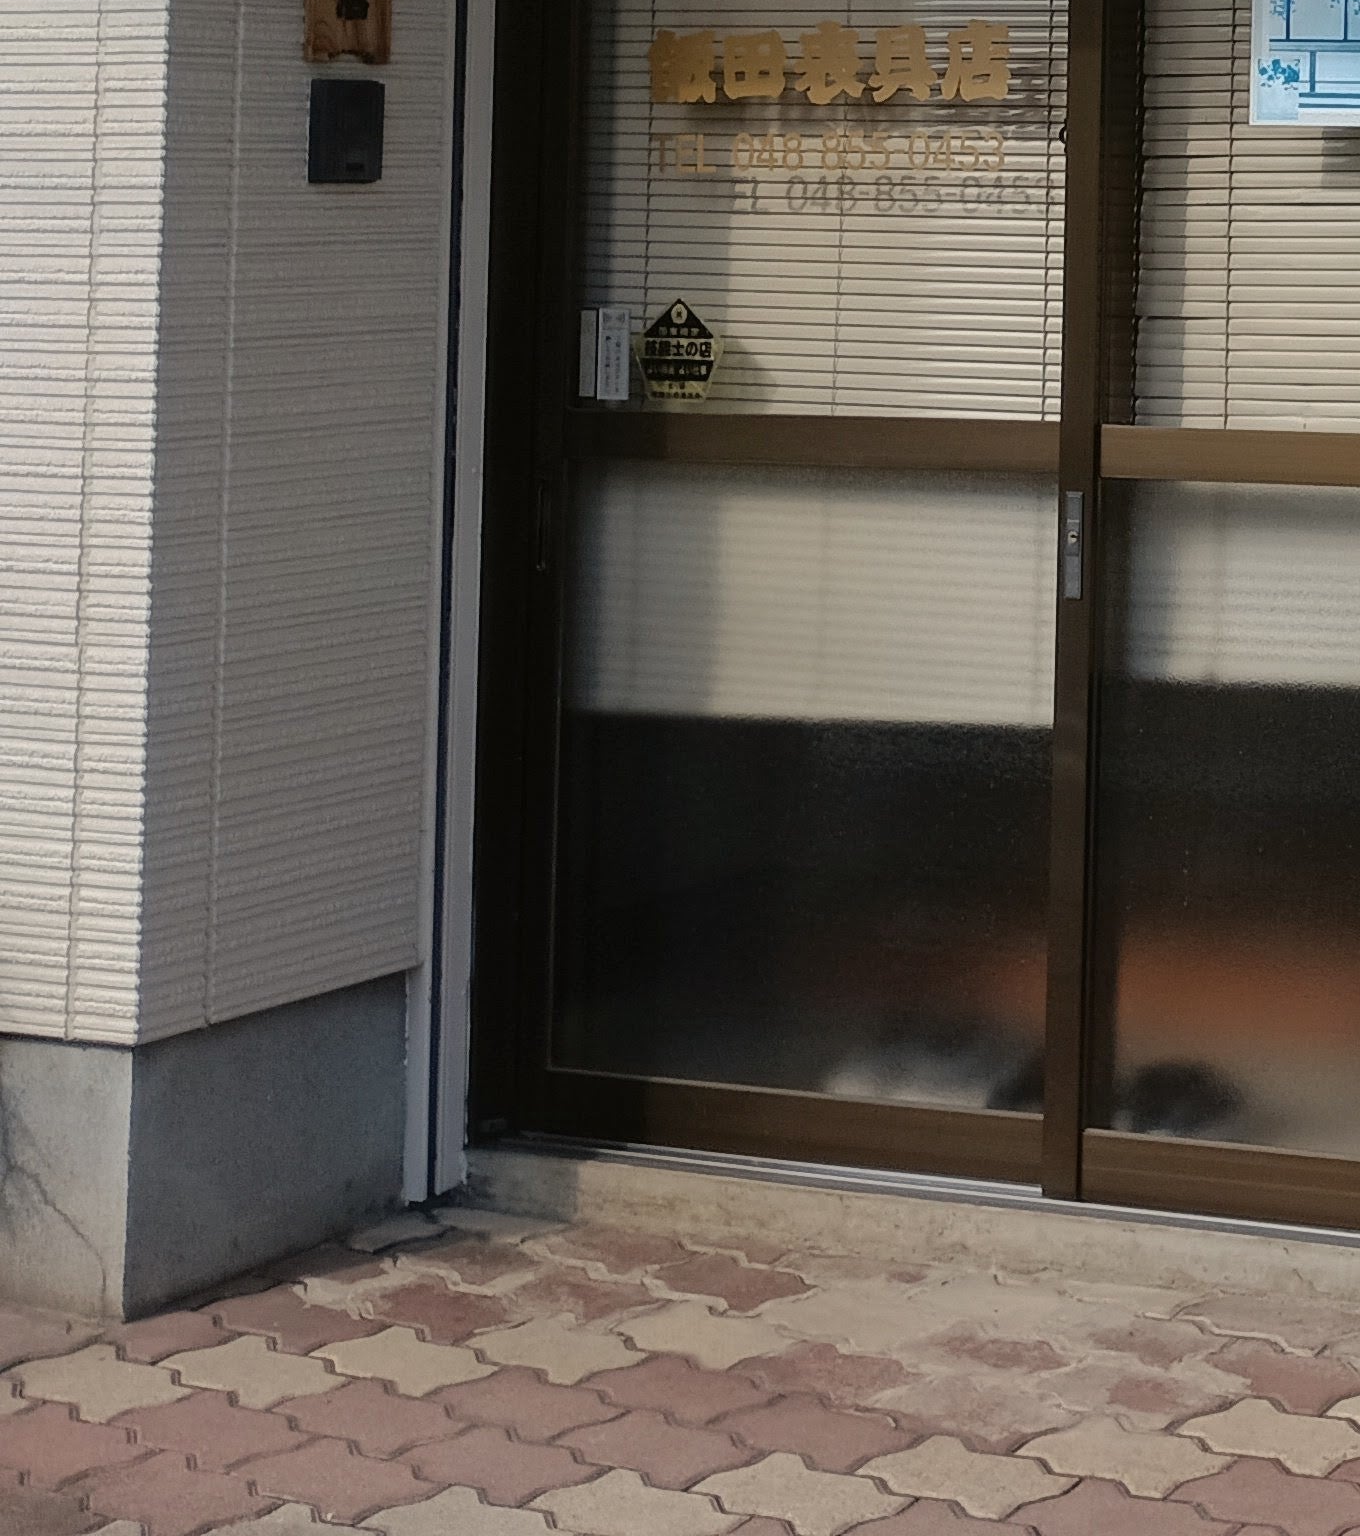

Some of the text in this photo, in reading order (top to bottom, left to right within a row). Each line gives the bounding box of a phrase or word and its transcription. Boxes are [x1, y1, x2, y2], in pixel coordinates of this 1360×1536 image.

[648, 20, 1011, 104] 飯田表具店
[652, 133, 717, 174] TEL
